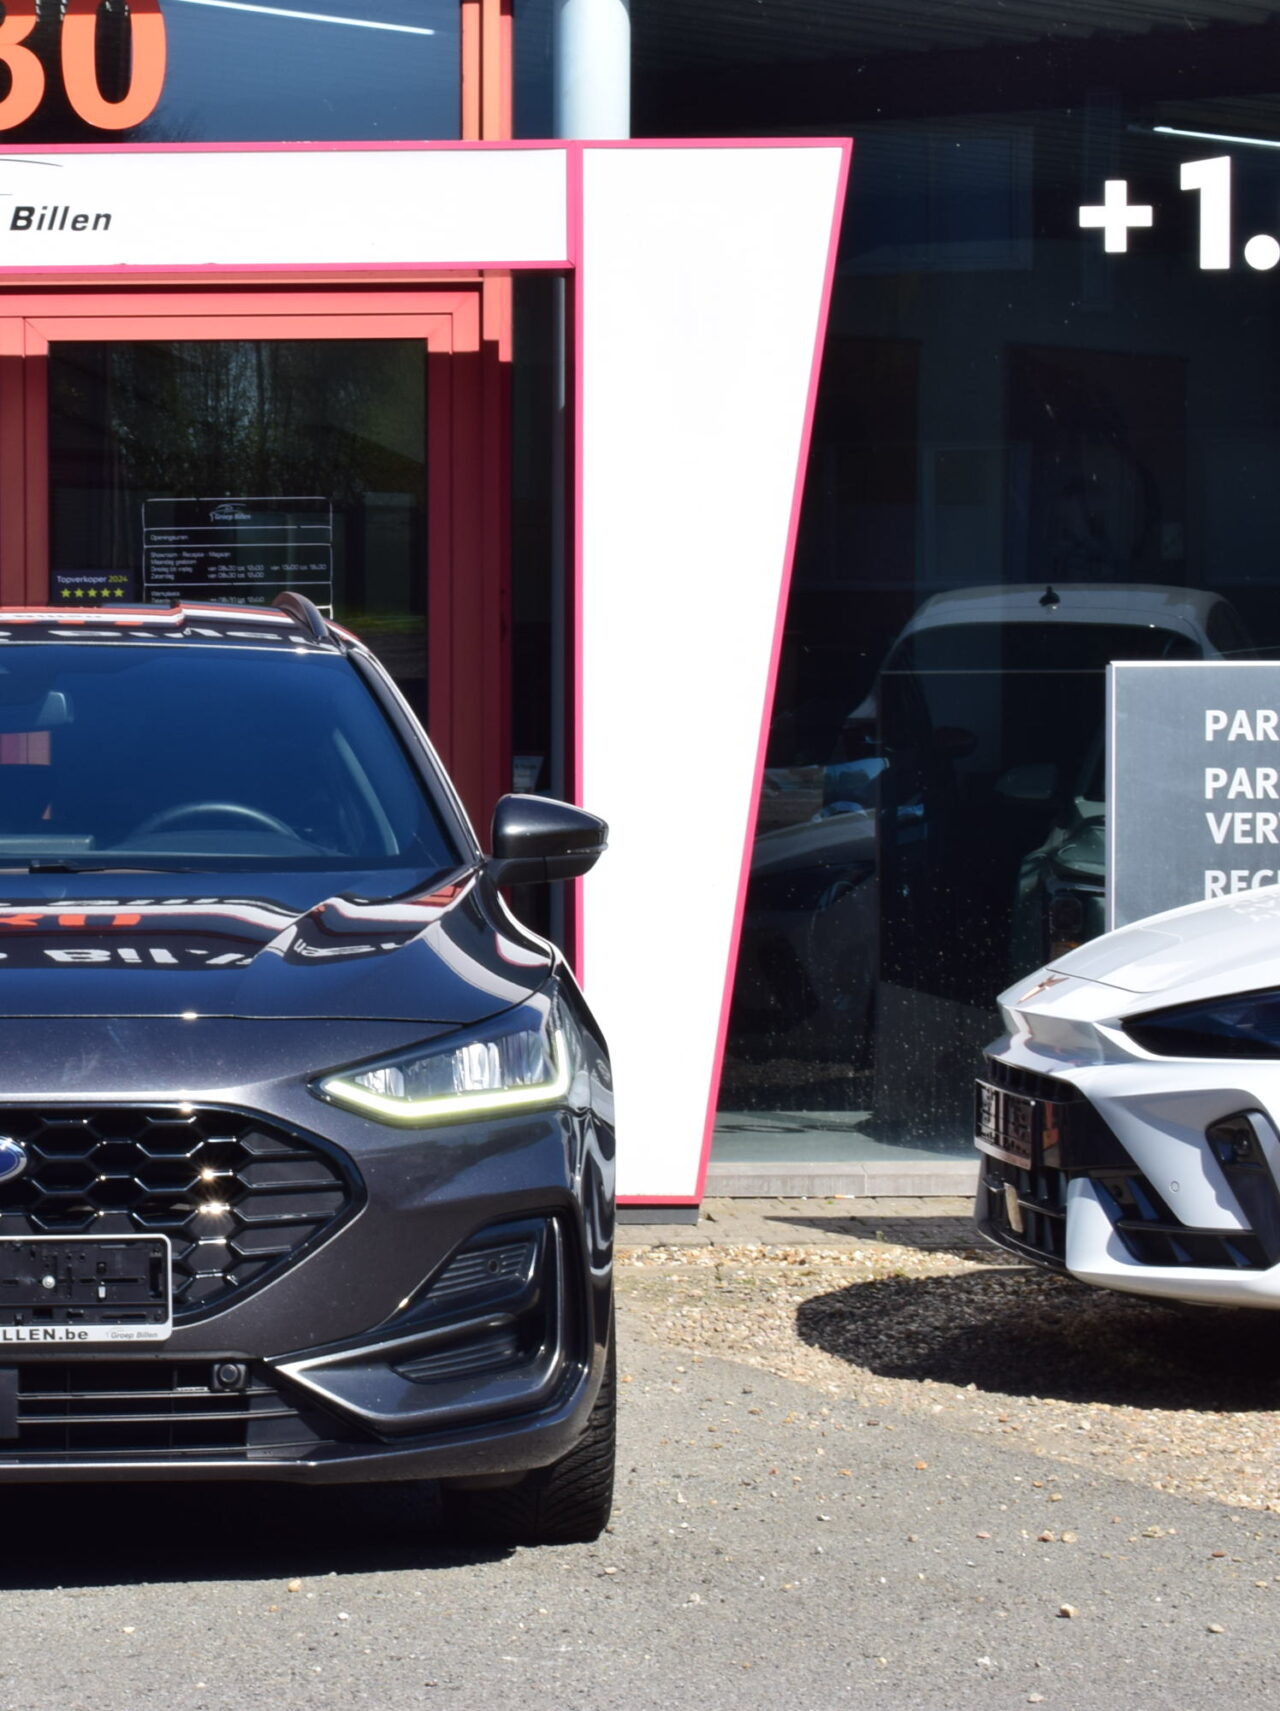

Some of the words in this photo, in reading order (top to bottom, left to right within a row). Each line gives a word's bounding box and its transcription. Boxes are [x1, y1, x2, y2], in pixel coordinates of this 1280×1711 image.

[9, 204, 113, 232] Billen
[56, 575, 108, 585] Topverkoper
[108, 574, 129, 584] 2024
[1205, 811, 1280, 845] VER
[1204, 869, 1280, 900] REC
